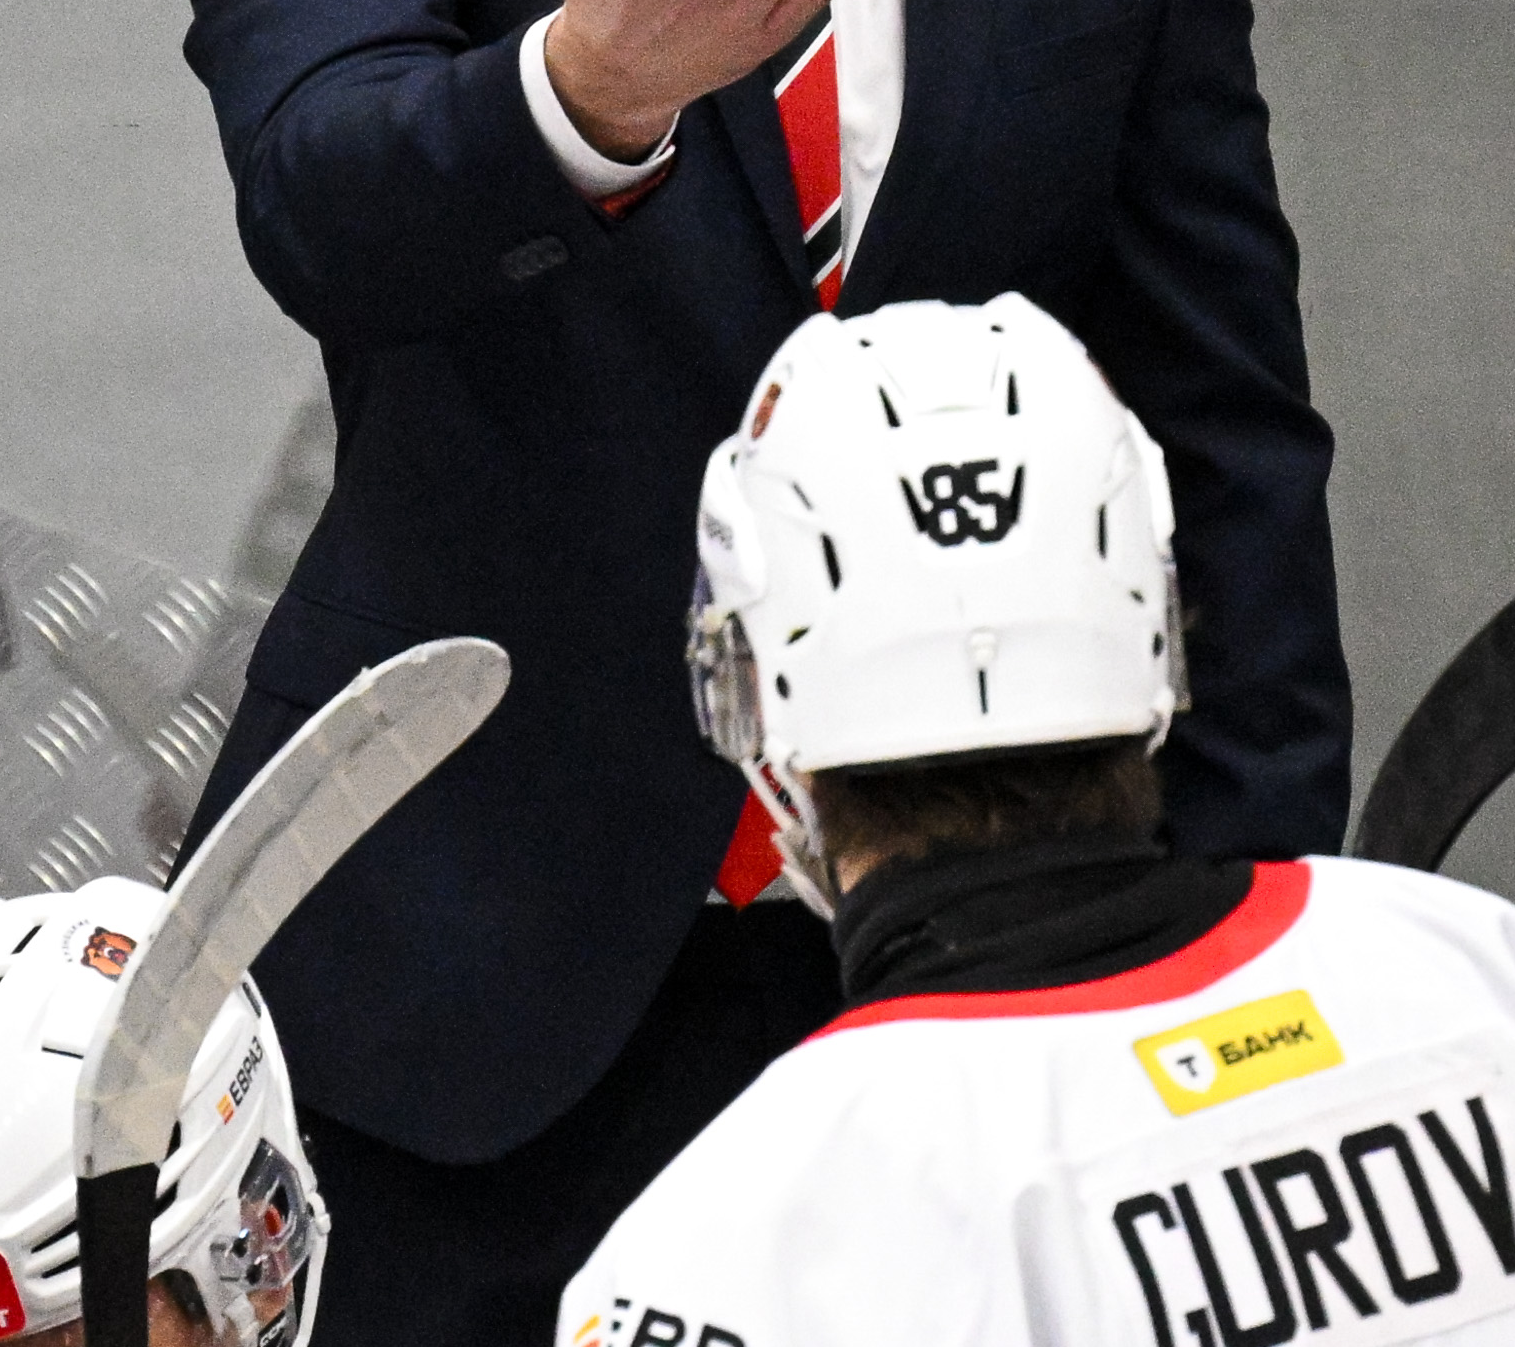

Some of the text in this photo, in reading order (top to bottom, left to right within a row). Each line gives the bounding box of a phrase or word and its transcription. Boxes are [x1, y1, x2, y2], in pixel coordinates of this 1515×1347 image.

[922, 459, 1002, 548] 85
[229, 1035, 265, 1107] ЕВРАЗ
[1217, 1019, 1314, 1066] БАНК
